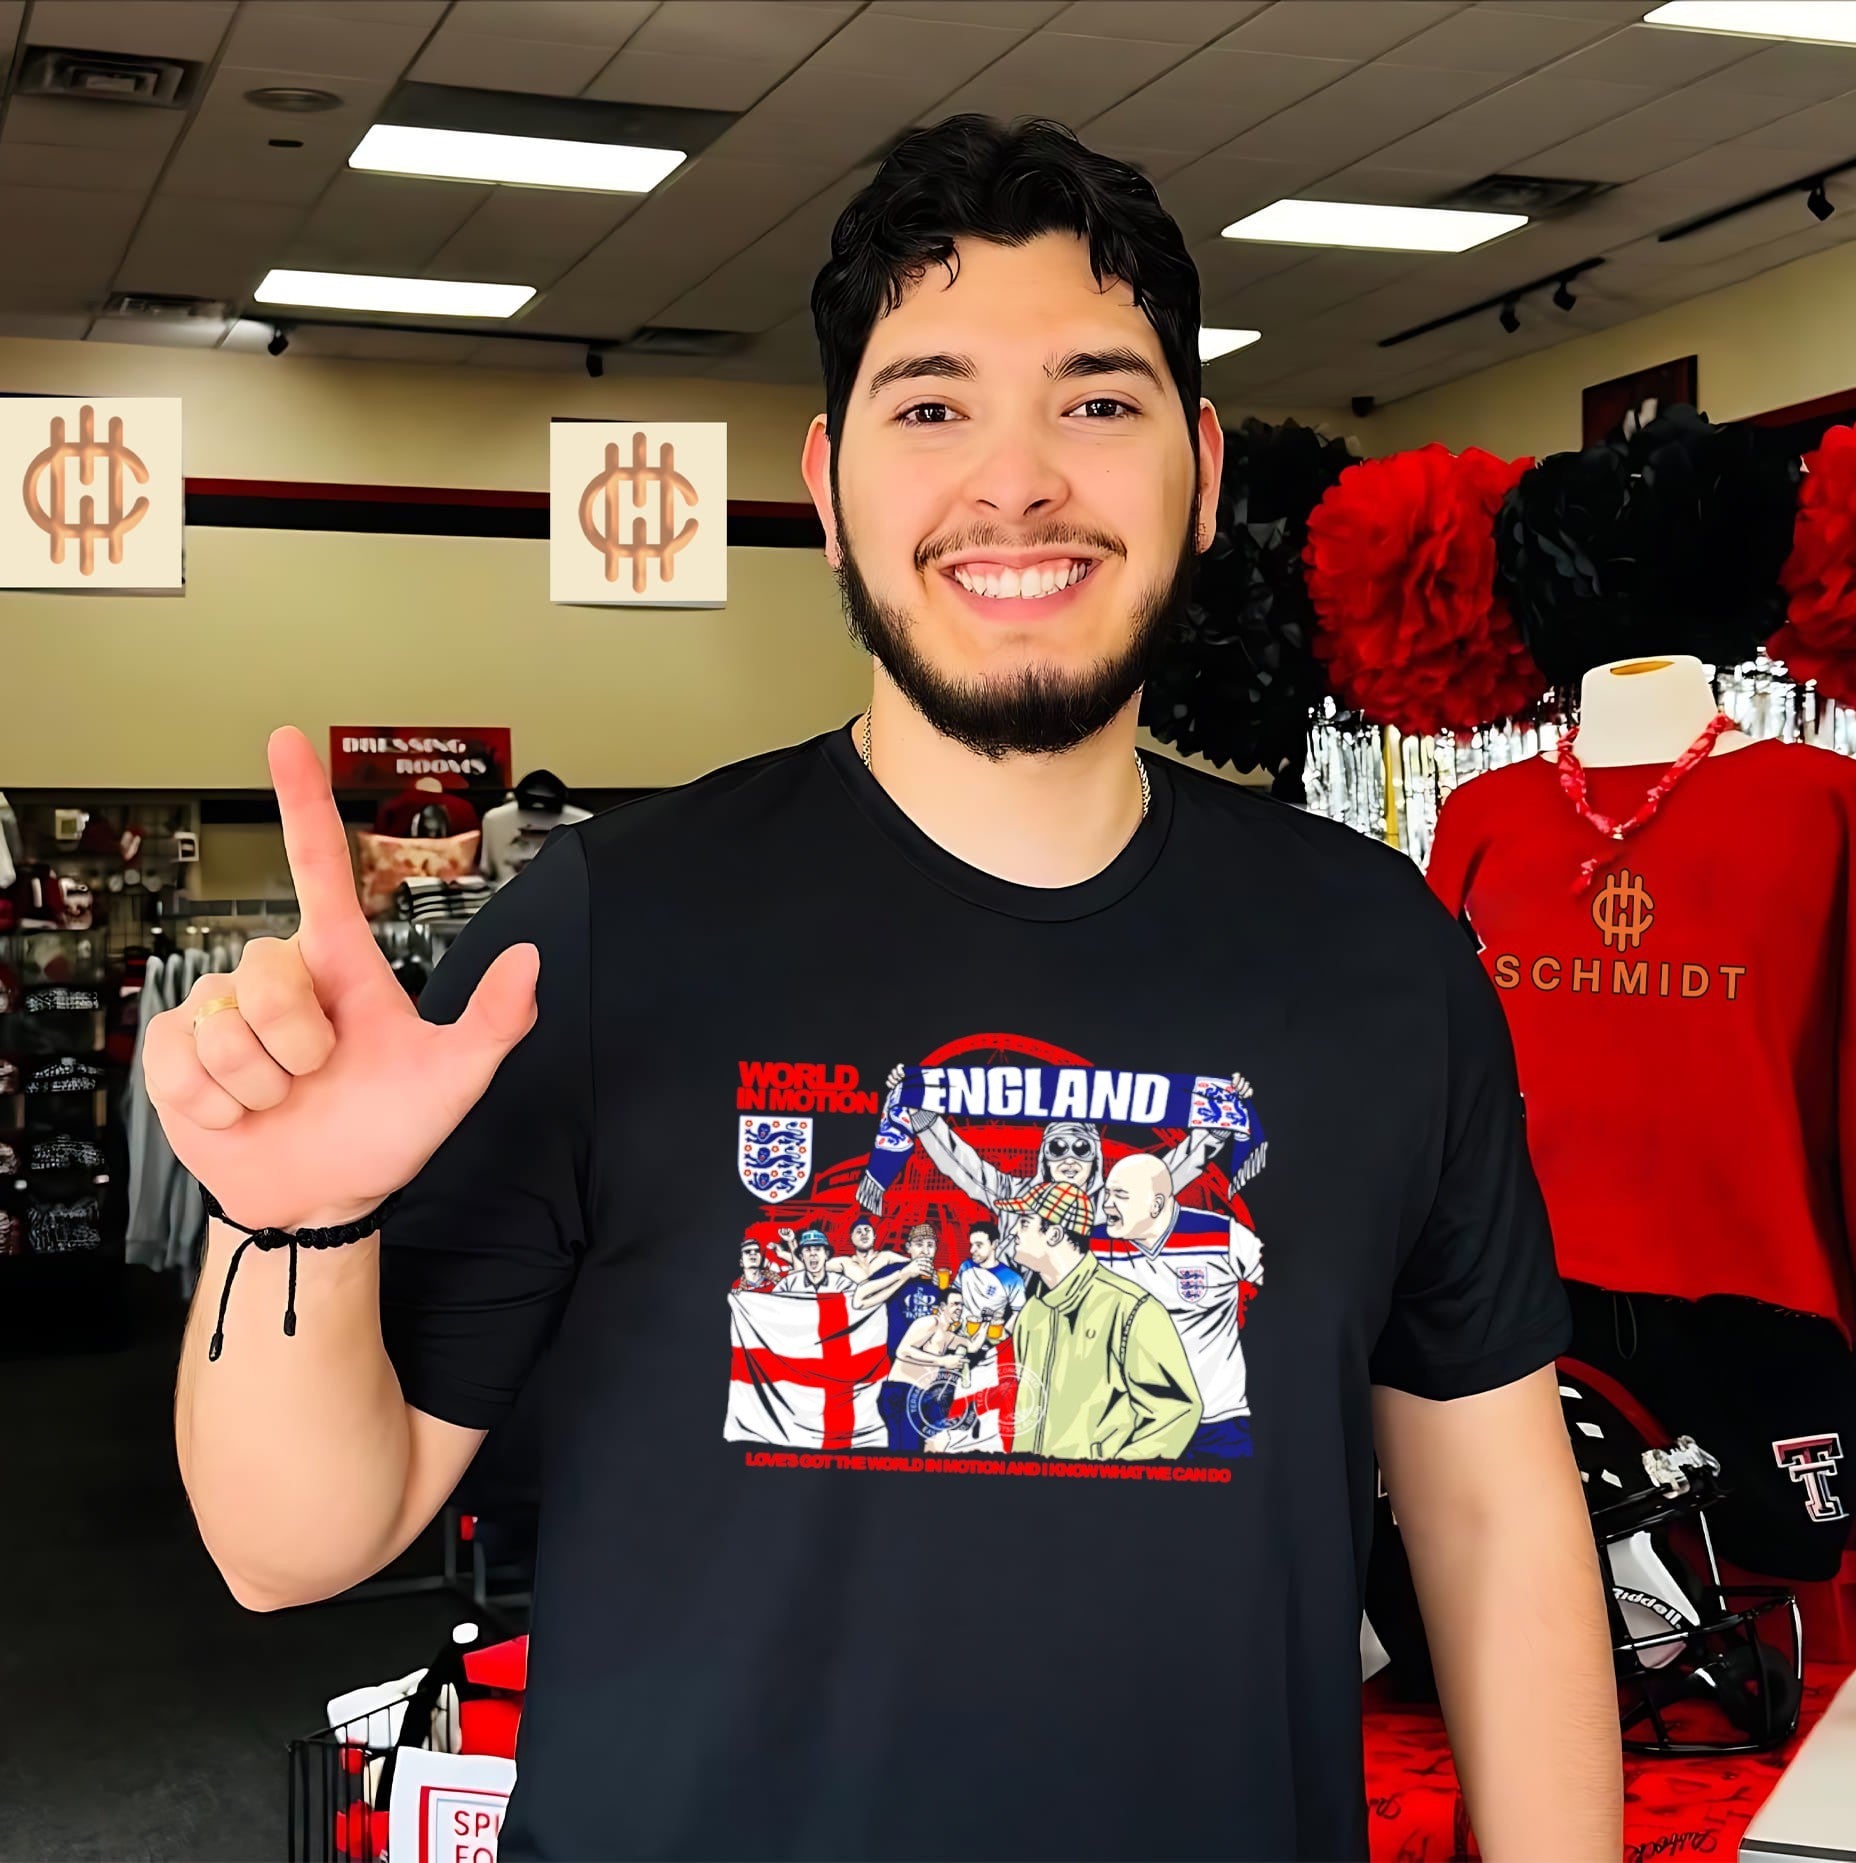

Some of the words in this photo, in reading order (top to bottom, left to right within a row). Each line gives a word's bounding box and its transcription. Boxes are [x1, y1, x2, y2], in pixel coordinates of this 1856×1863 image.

[1494, 953, 1747, 1001] SCHMIDT
[738, 1061, 860, 1091] WORLD
[736, 1087, 766, 1111] IN
[768, 1088, 879, 1114] MOTION
[921, 1066, 1171, 1124] ENGLAND
[799, 1453, 831, 1469] GOT
[831, 1454, 867, 1471] THE
[868, 1455, 924, 1472] WORLD
[924, 1457, 942, 1473] IN
[943, 1458, 1006, 1475] MOTION
[1006, 1460, 1042, 1476] AND
[1049, 1462, 1100, 1478] KNOW
[1100, 1463, 1147, 1481] WHAT
[1147, 1465, 1173, 1481] WE
[1172, 1466, 1208, 1483] CAN
[1207, 1468, 1232, 1483] DO
